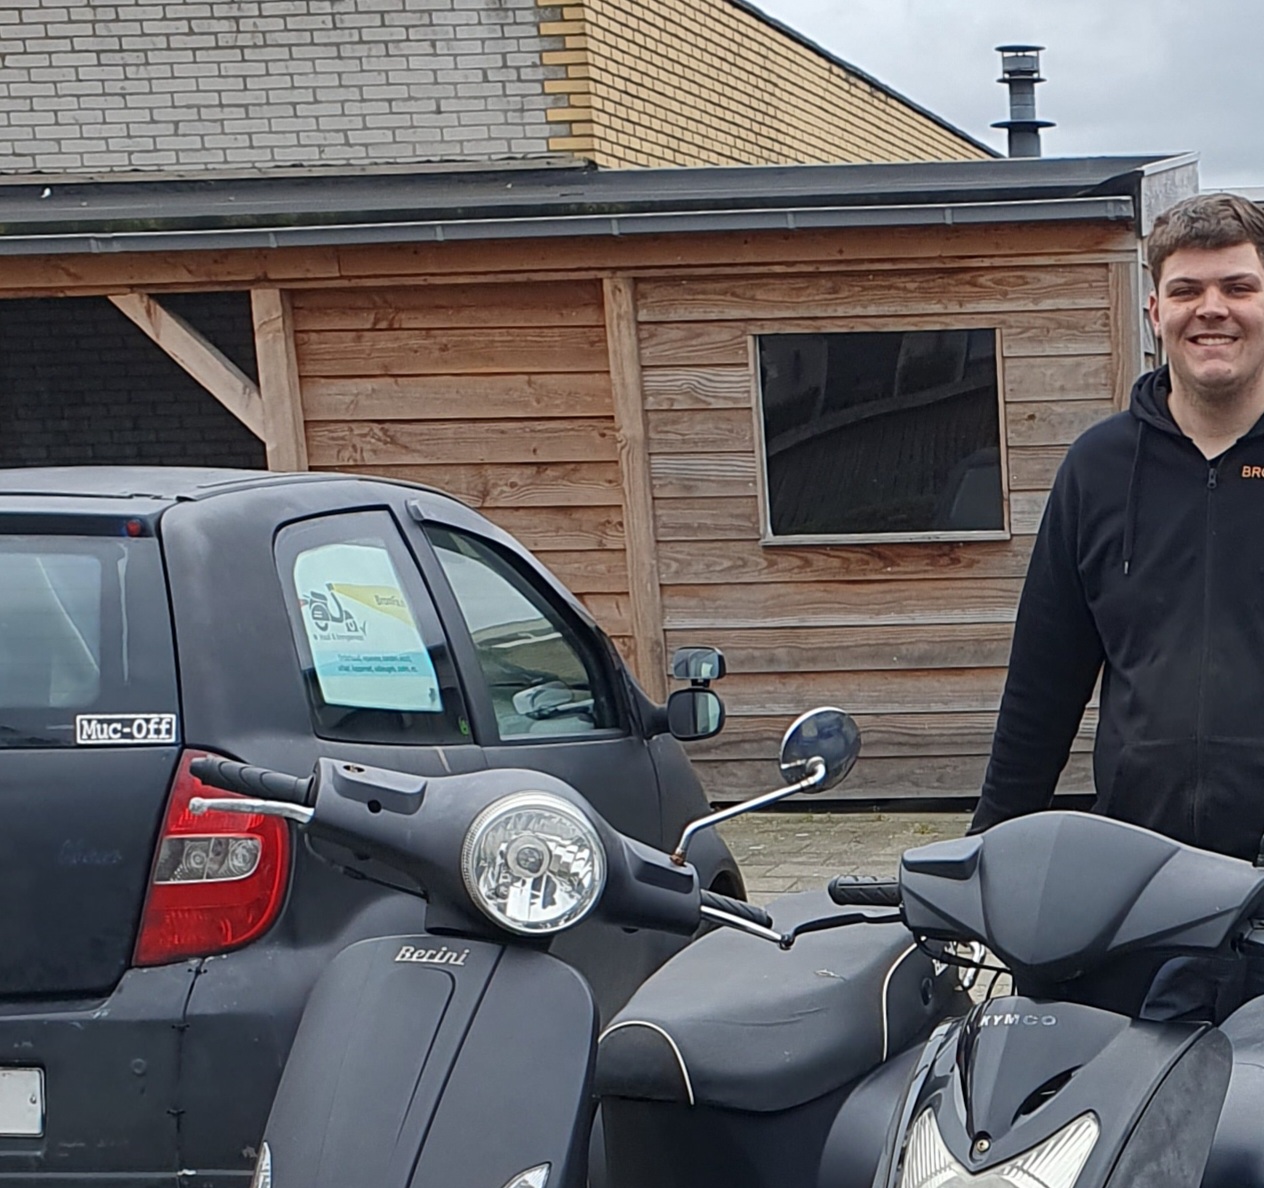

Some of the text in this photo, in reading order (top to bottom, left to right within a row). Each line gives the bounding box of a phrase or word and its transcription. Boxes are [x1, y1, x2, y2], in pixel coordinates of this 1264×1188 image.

[81, 718, 171, 740] Muc-Off
[394, 946, 470, 965] Berini
[979, 1014, 1056, 1026] KYMCO
